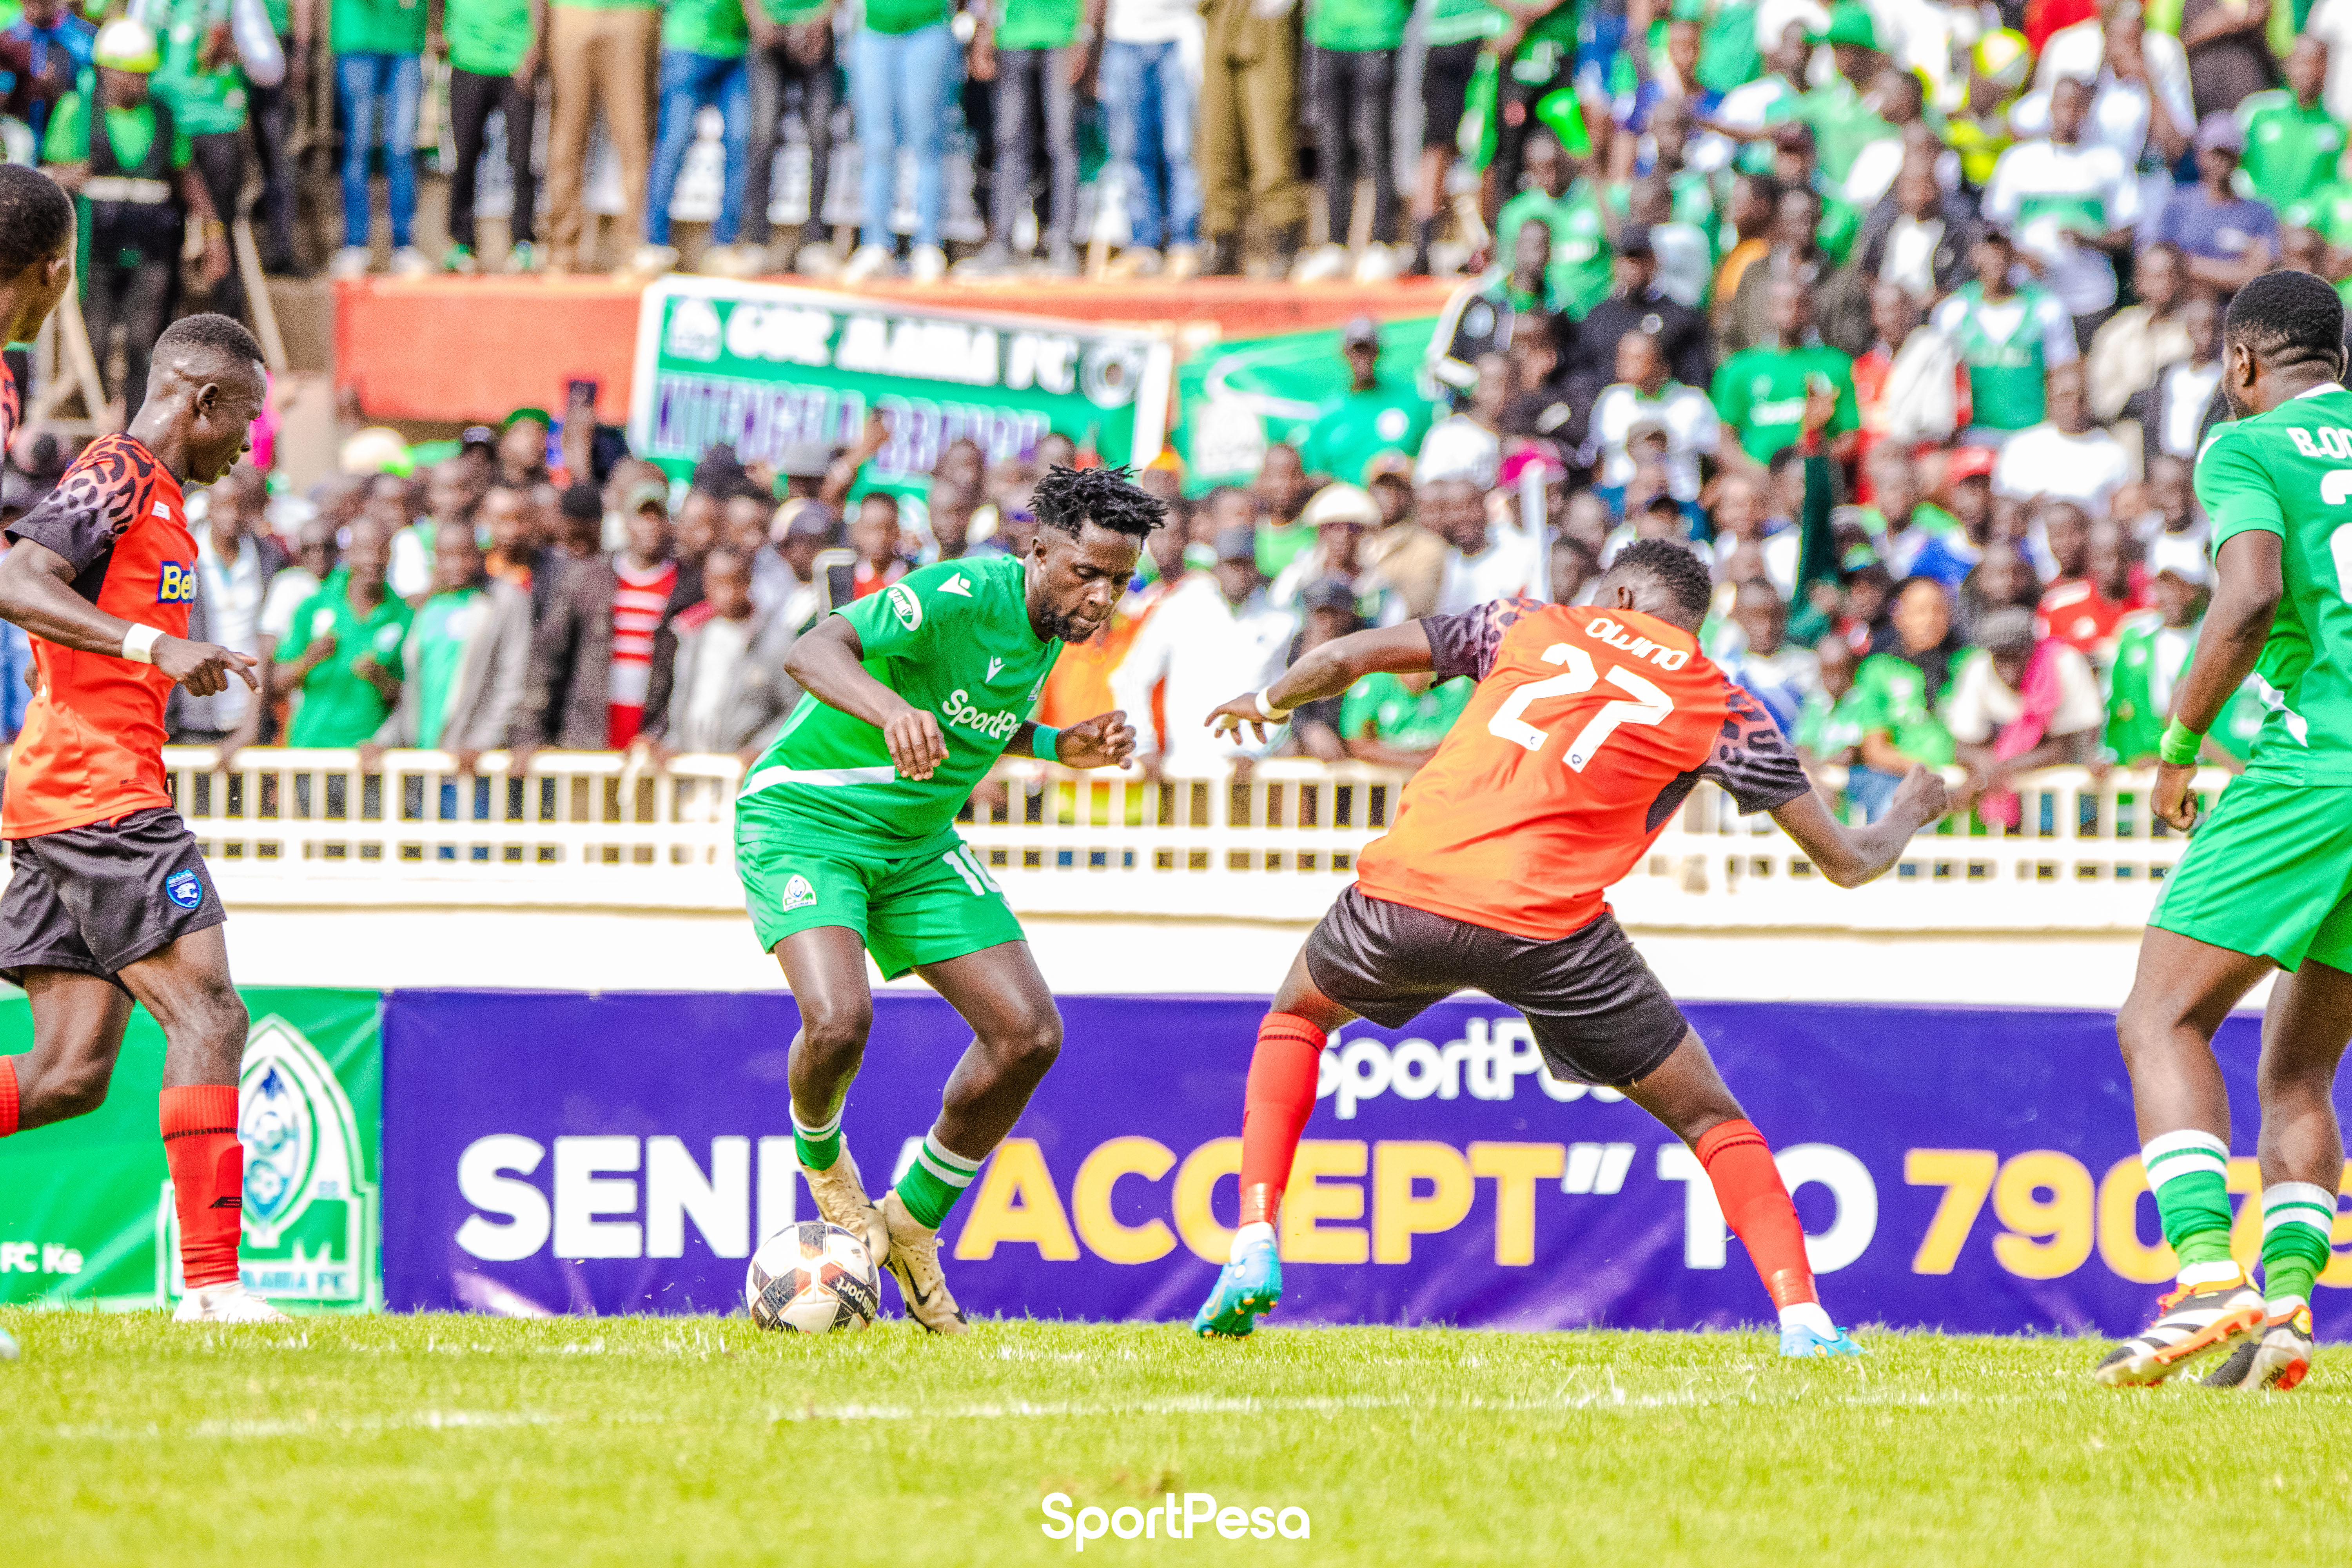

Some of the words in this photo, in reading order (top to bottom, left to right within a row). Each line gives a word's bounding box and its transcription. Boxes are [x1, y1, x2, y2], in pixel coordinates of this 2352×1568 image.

[1488, 642, 1675, 773] 27
[1, 1241, 38, 1273] FC
[42, 1242, 83, 1274] Ke
[1657, 1142, 1878, 1275] TO
